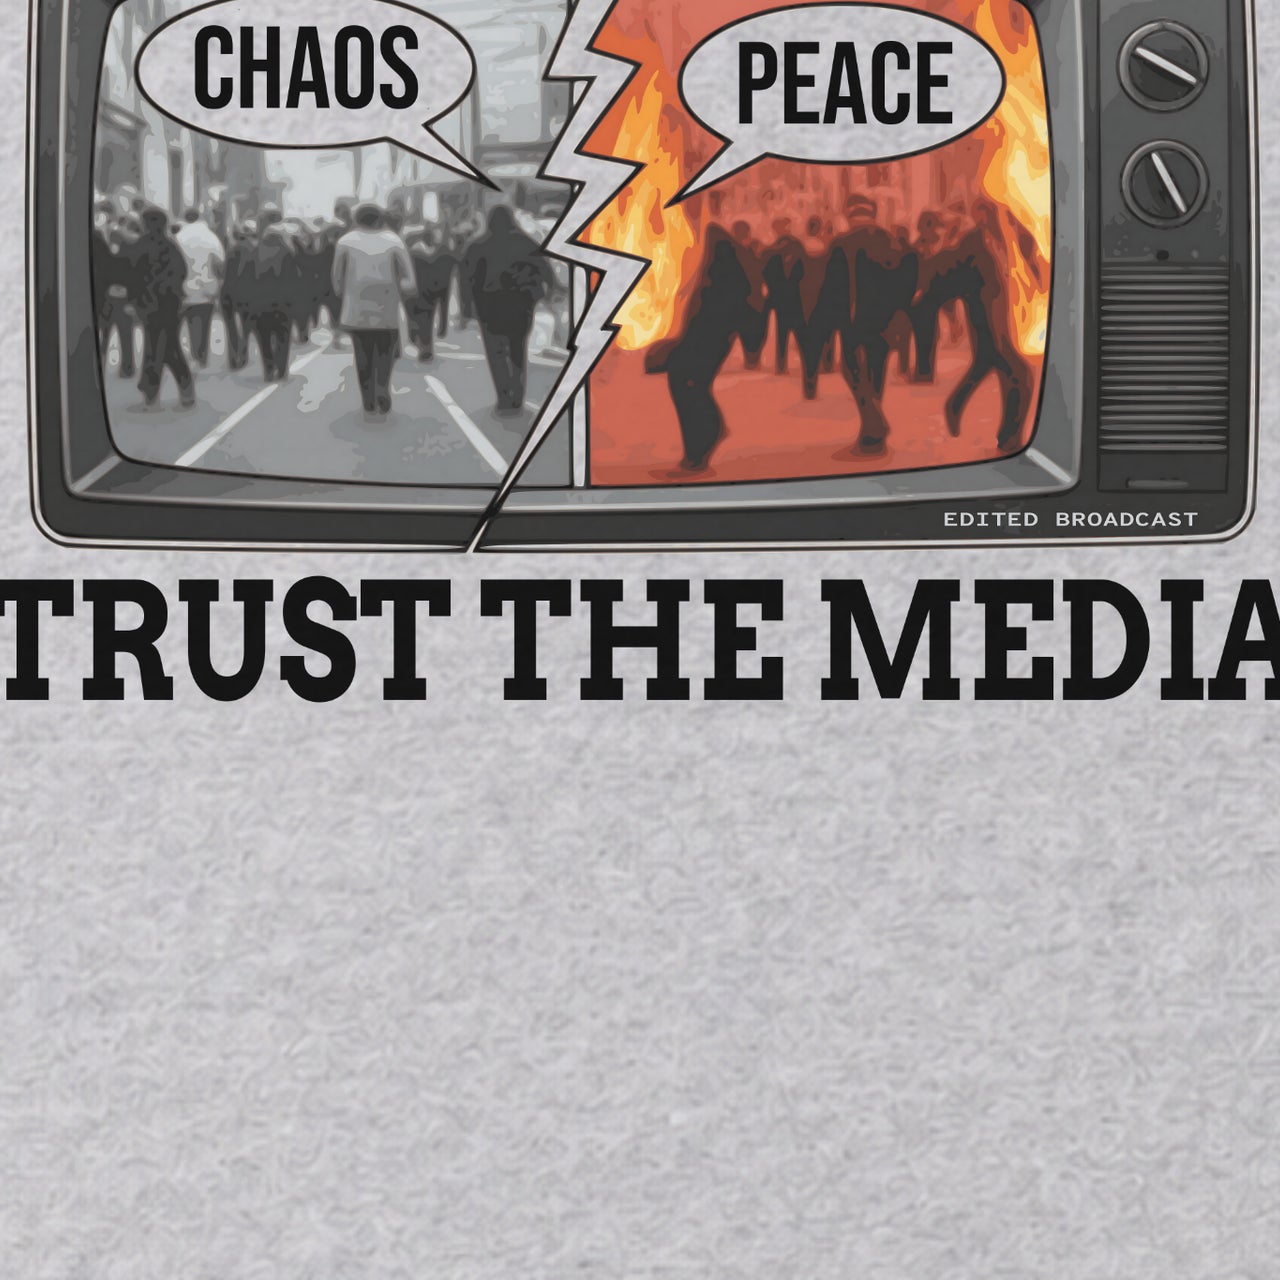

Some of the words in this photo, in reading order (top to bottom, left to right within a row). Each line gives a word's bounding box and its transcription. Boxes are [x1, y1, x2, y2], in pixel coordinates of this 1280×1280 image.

[195, 25, 418, 109] CHAOS
[739, 41, 952, 124] PEACE
[944, 512, 1039, 527] EDITED
[1056, 512, 1199, 527] BROADCAST
[481, 576, 783, 702] THE
